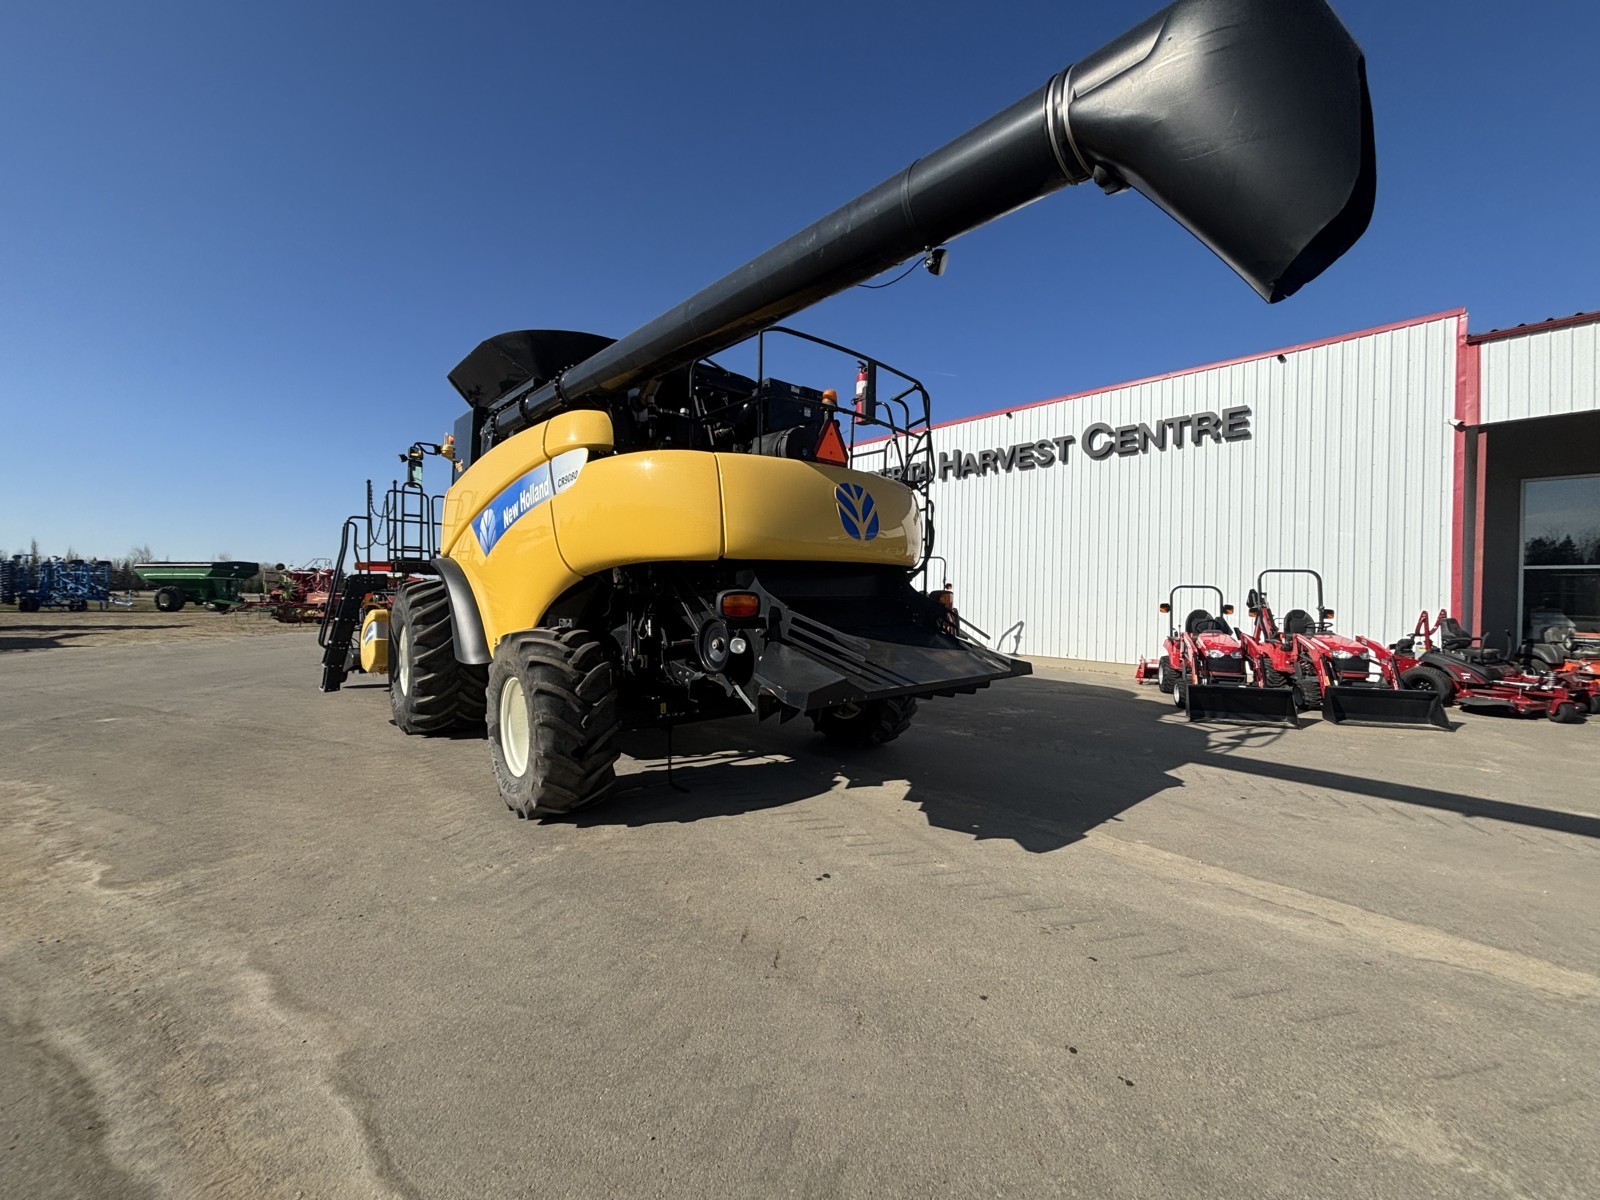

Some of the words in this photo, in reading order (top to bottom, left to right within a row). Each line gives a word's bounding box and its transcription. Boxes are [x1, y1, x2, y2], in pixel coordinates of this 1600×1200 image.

[939, 435, 1076, 482] HARVEST
[1081, 405, 1252, 461] CENTRE
[503, 500, 519, 529] New
[520, 474, 549, 512] Holland
